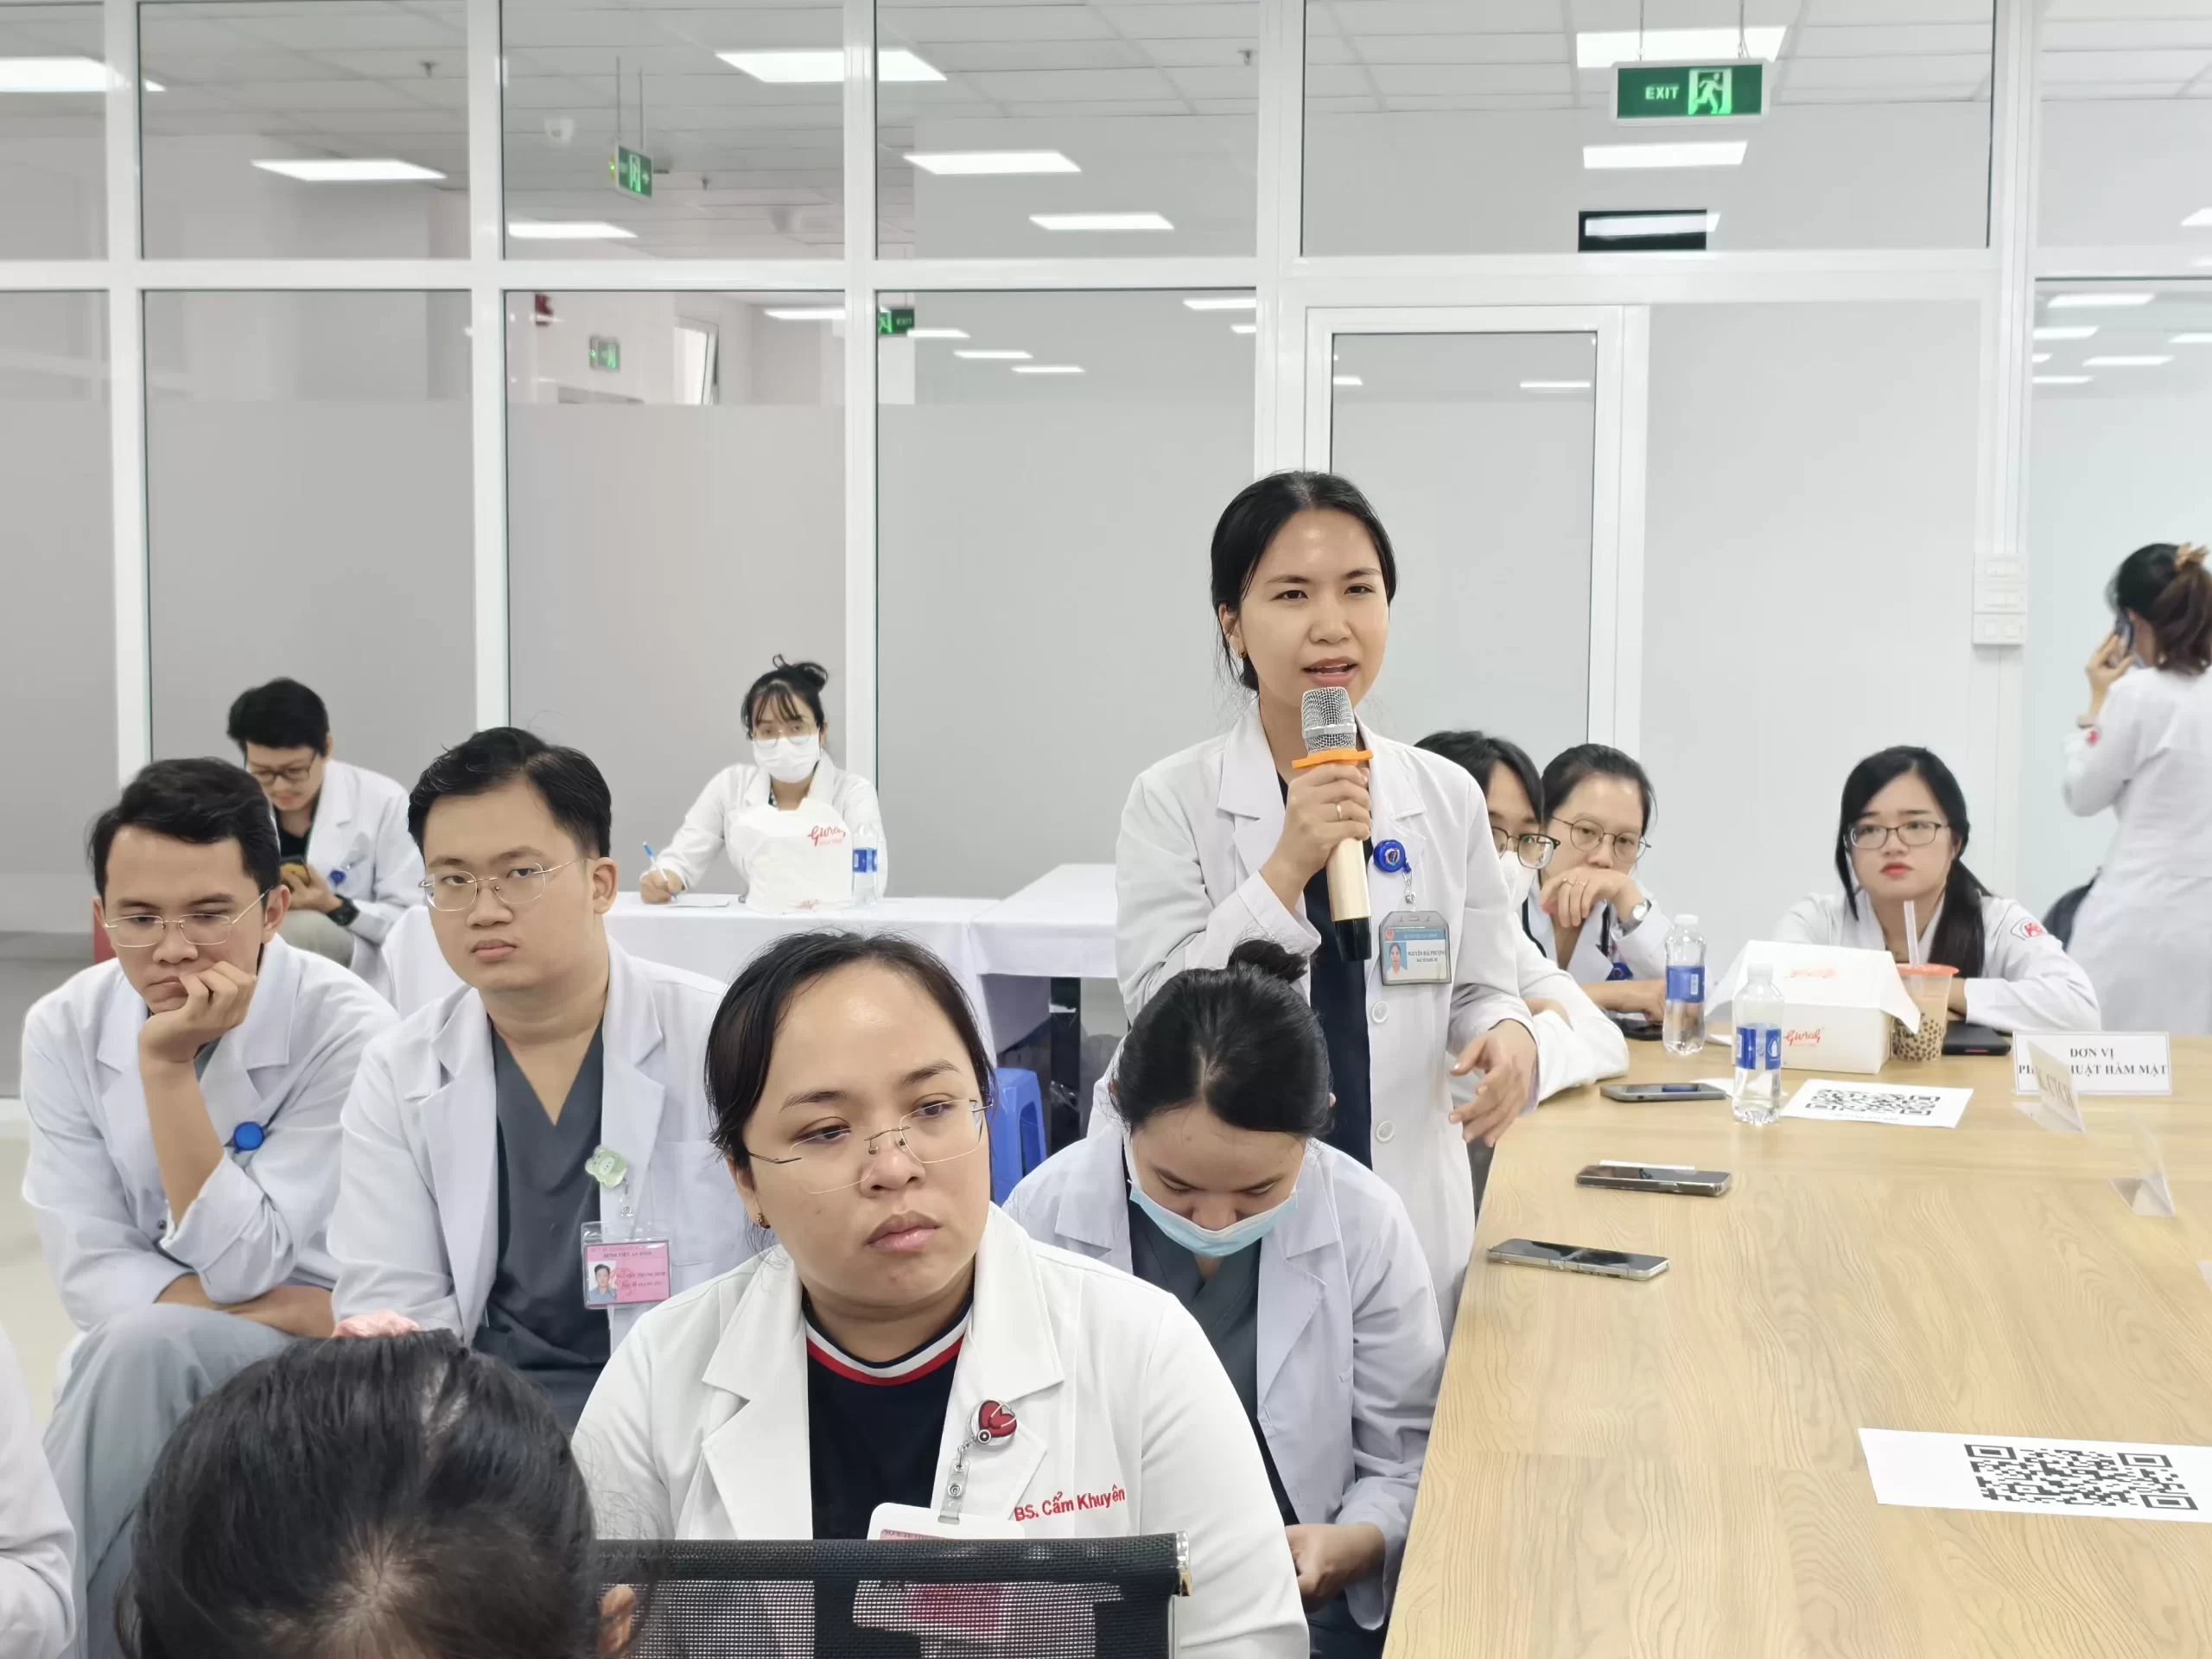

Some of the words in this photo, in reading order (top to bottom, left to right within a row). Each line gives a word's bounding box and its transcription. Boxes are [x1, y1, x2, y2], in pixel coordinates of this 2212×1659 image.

[1644, 86, 1680, 100] EXIT
[2101, 1047, 2114, 1061] VỊ
[2105, 1061, 2135, 1075] HÀM
[1014, 1503, 1039, 1522] BS.
[1041, 1491, 1074, 1516] Cẩm
[1077, 1484, 1125, 1510] Khuyên
